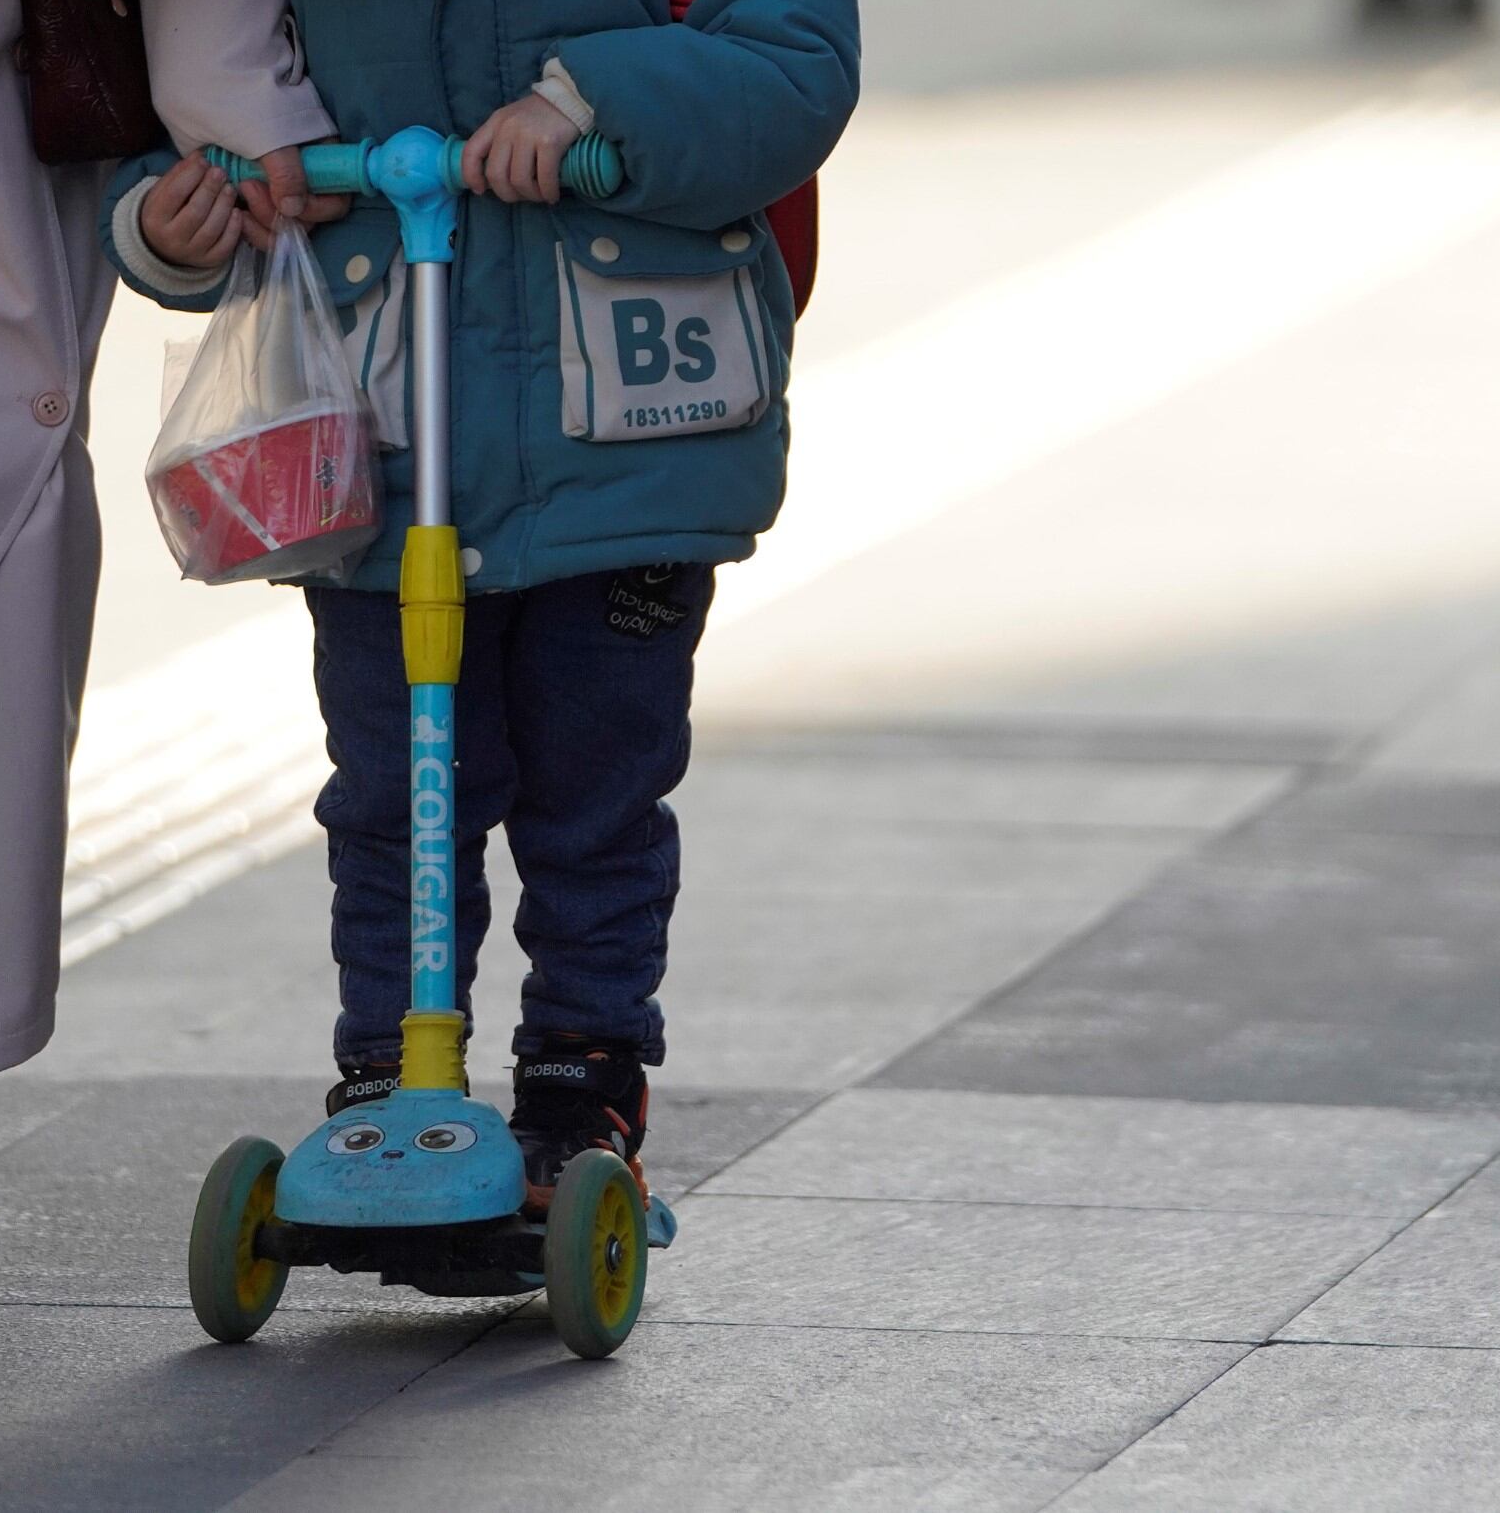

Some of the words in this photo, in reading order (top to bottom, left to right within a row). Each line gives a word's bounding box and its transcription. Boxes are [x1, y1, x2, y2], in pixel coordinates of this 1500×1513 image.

[611, 298, 717, 386] Bs
[624, 399, 727, 428] 18311290
[412, 756, 448, 973] COUGAR
[524, 1063, 586, 1079] BOBDOG
